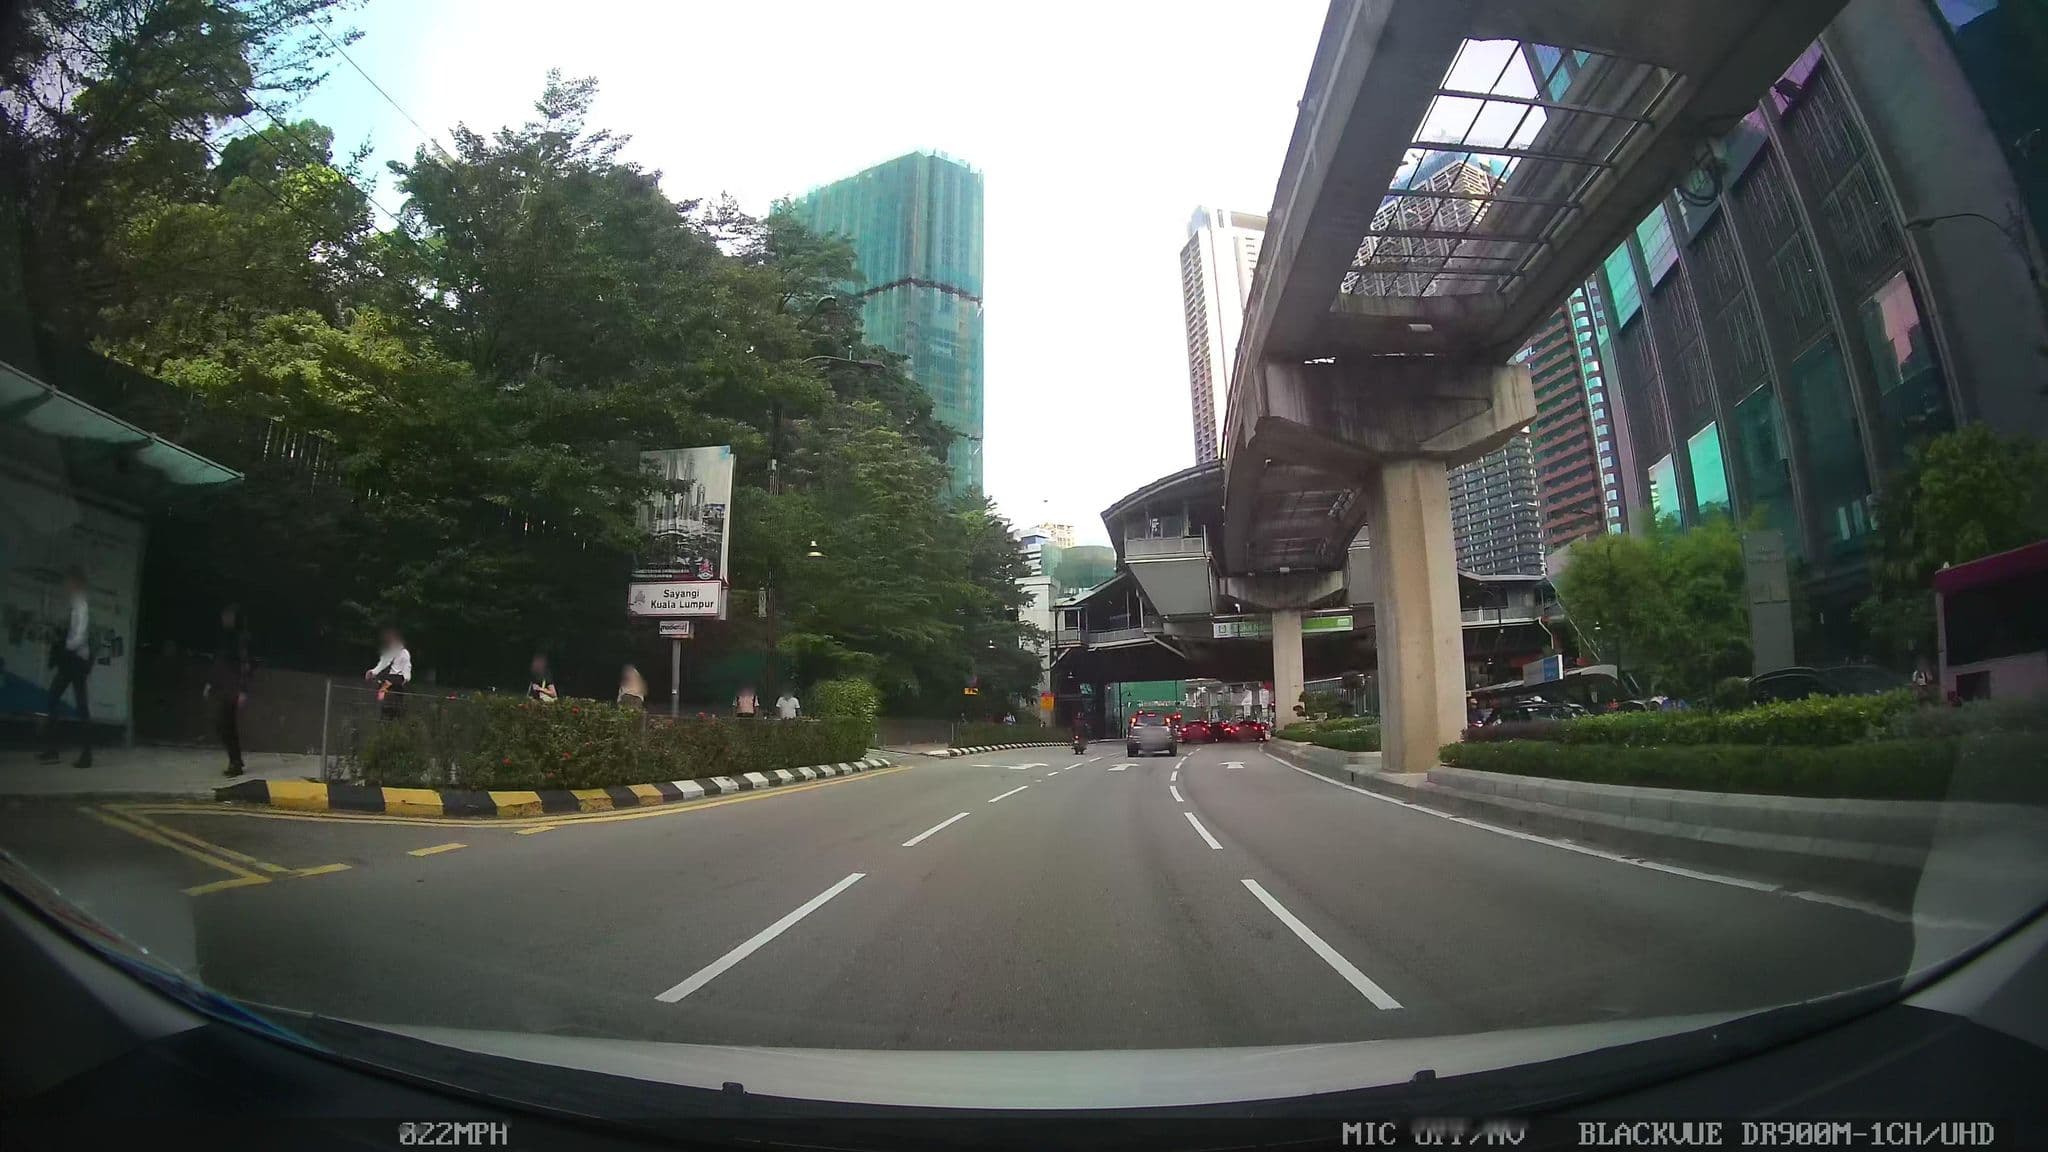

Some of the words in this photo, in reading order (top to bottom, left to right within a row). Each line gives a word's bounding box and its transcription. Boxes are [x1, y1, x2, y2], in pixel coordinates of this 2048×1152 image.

[663, 589, 700, 599] Sayangi
[651, 600, 676, 609] Kuala
[679, 600, 714, 610] Lumpur
